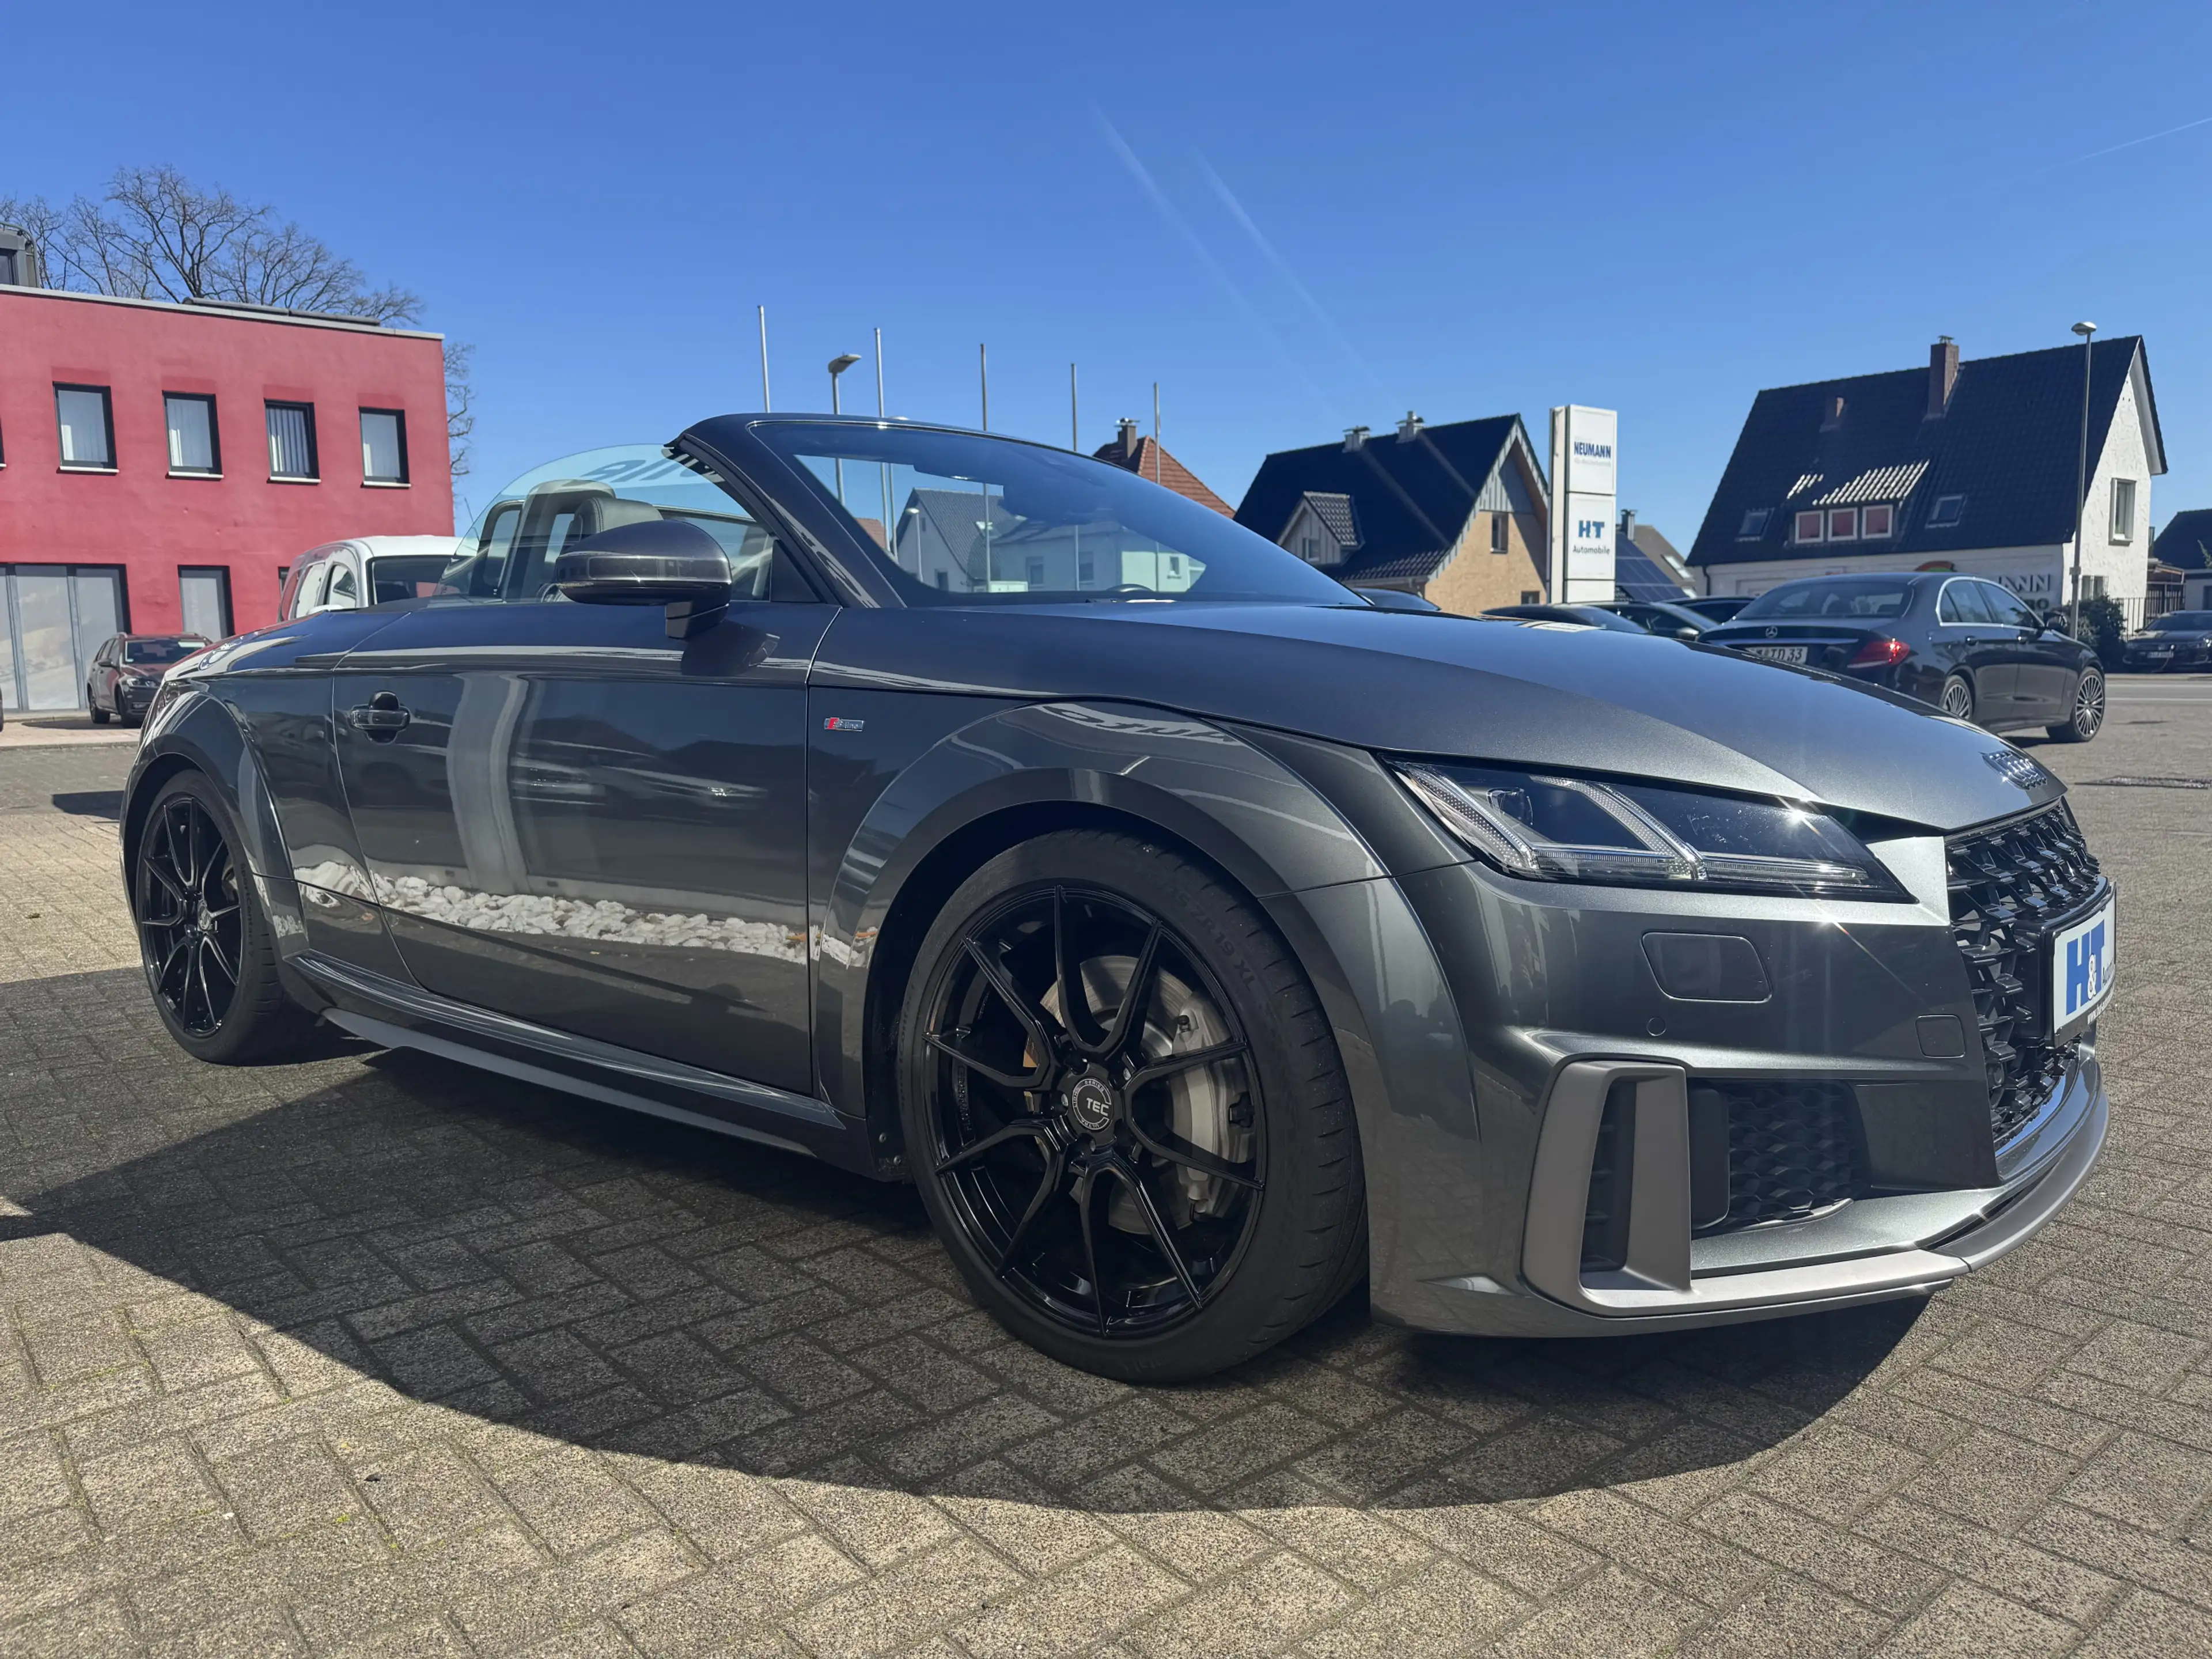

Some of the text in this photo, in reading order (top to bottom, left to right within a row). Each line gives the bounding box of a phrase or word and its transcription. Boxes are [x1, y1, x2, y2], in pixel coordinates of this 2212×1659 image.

[1574, 441, 1611, 459] NEUMANN
[1578, 520, 1605, 538] HT
[1573, 545, 1611, 555] Automobile
[1998, 574, 2051, 593] ANN
[1086, 1097, 1109, 1116] TEC
